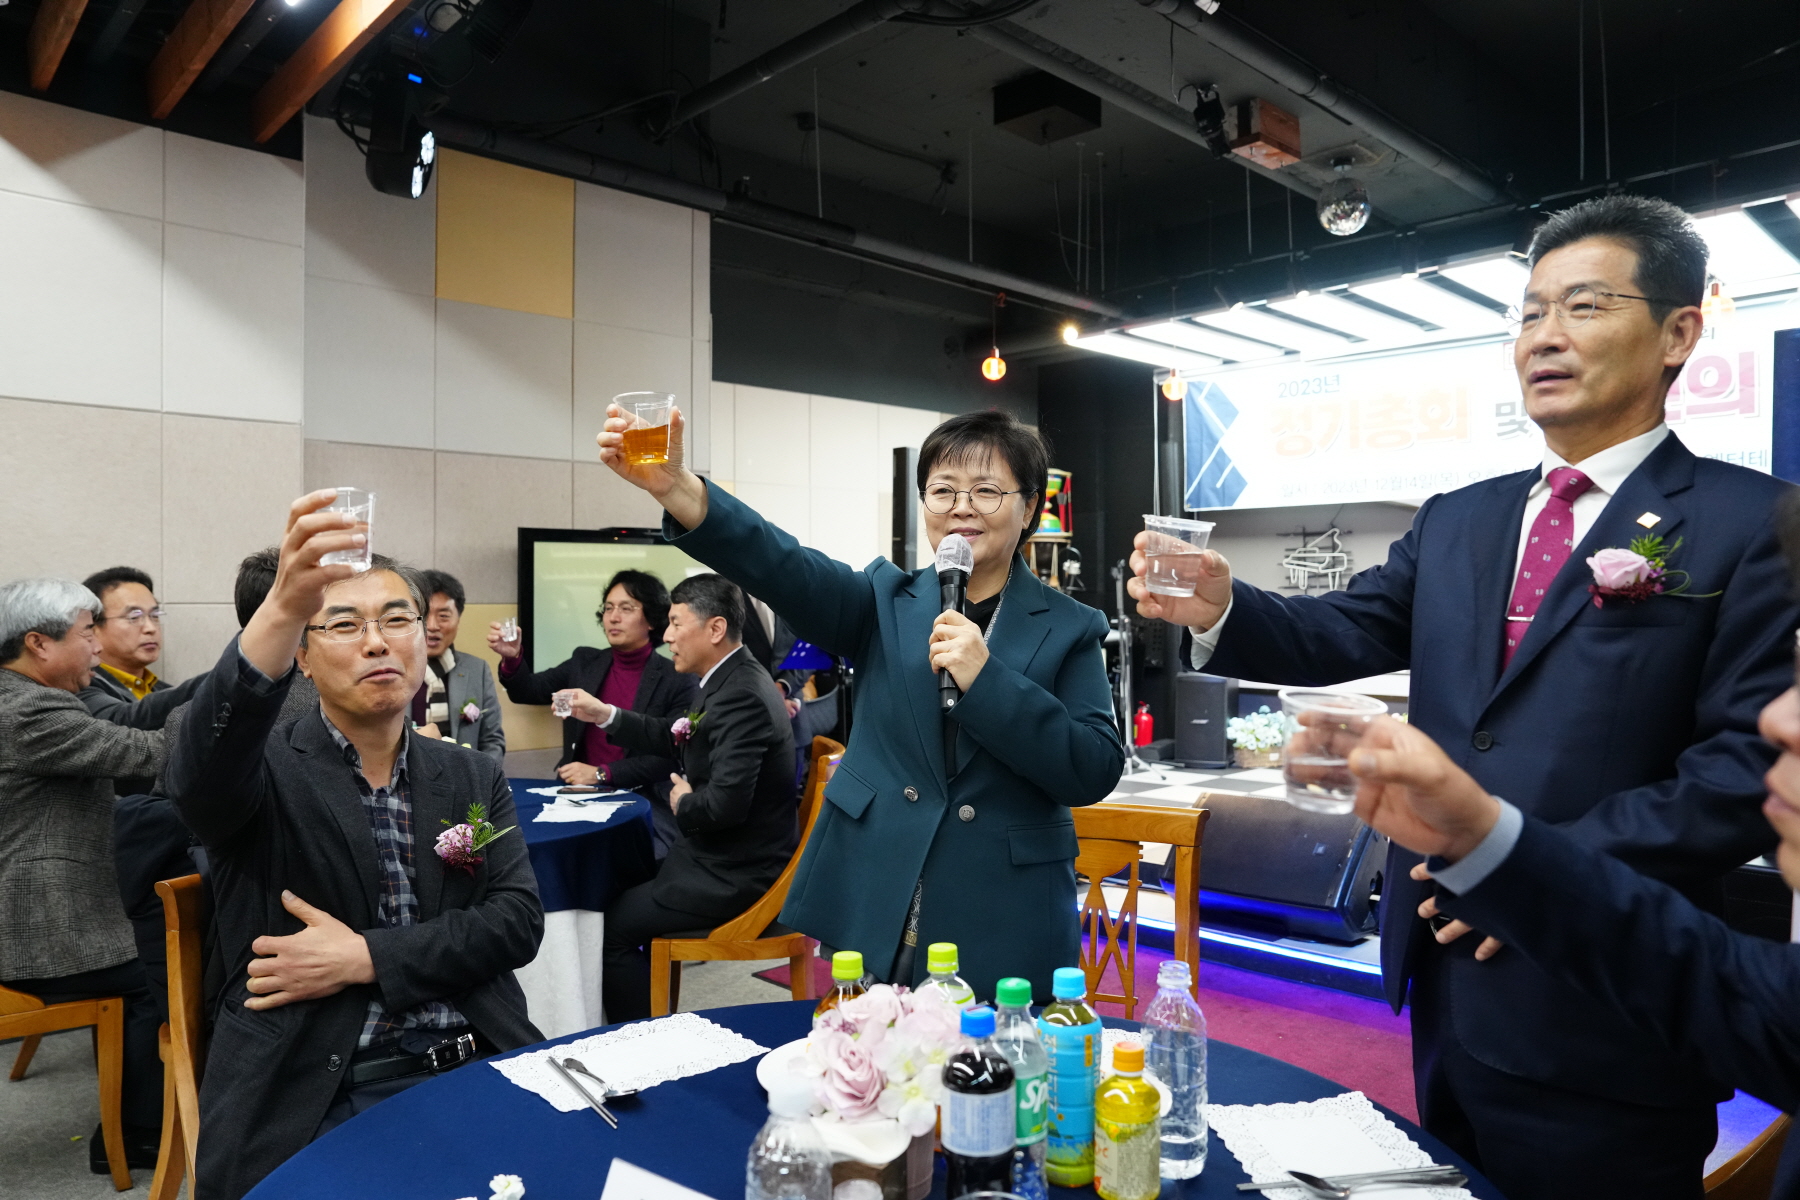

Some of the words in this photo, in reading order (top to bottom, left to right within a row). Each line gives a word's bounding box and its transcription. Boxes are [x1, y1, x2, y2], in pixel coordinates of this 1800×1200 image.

[1278, 374, 1341, 398] 2023년
[1270, 386, 1469, 458] 정기총회
[1322, 478, 1368, 494] 2023년
